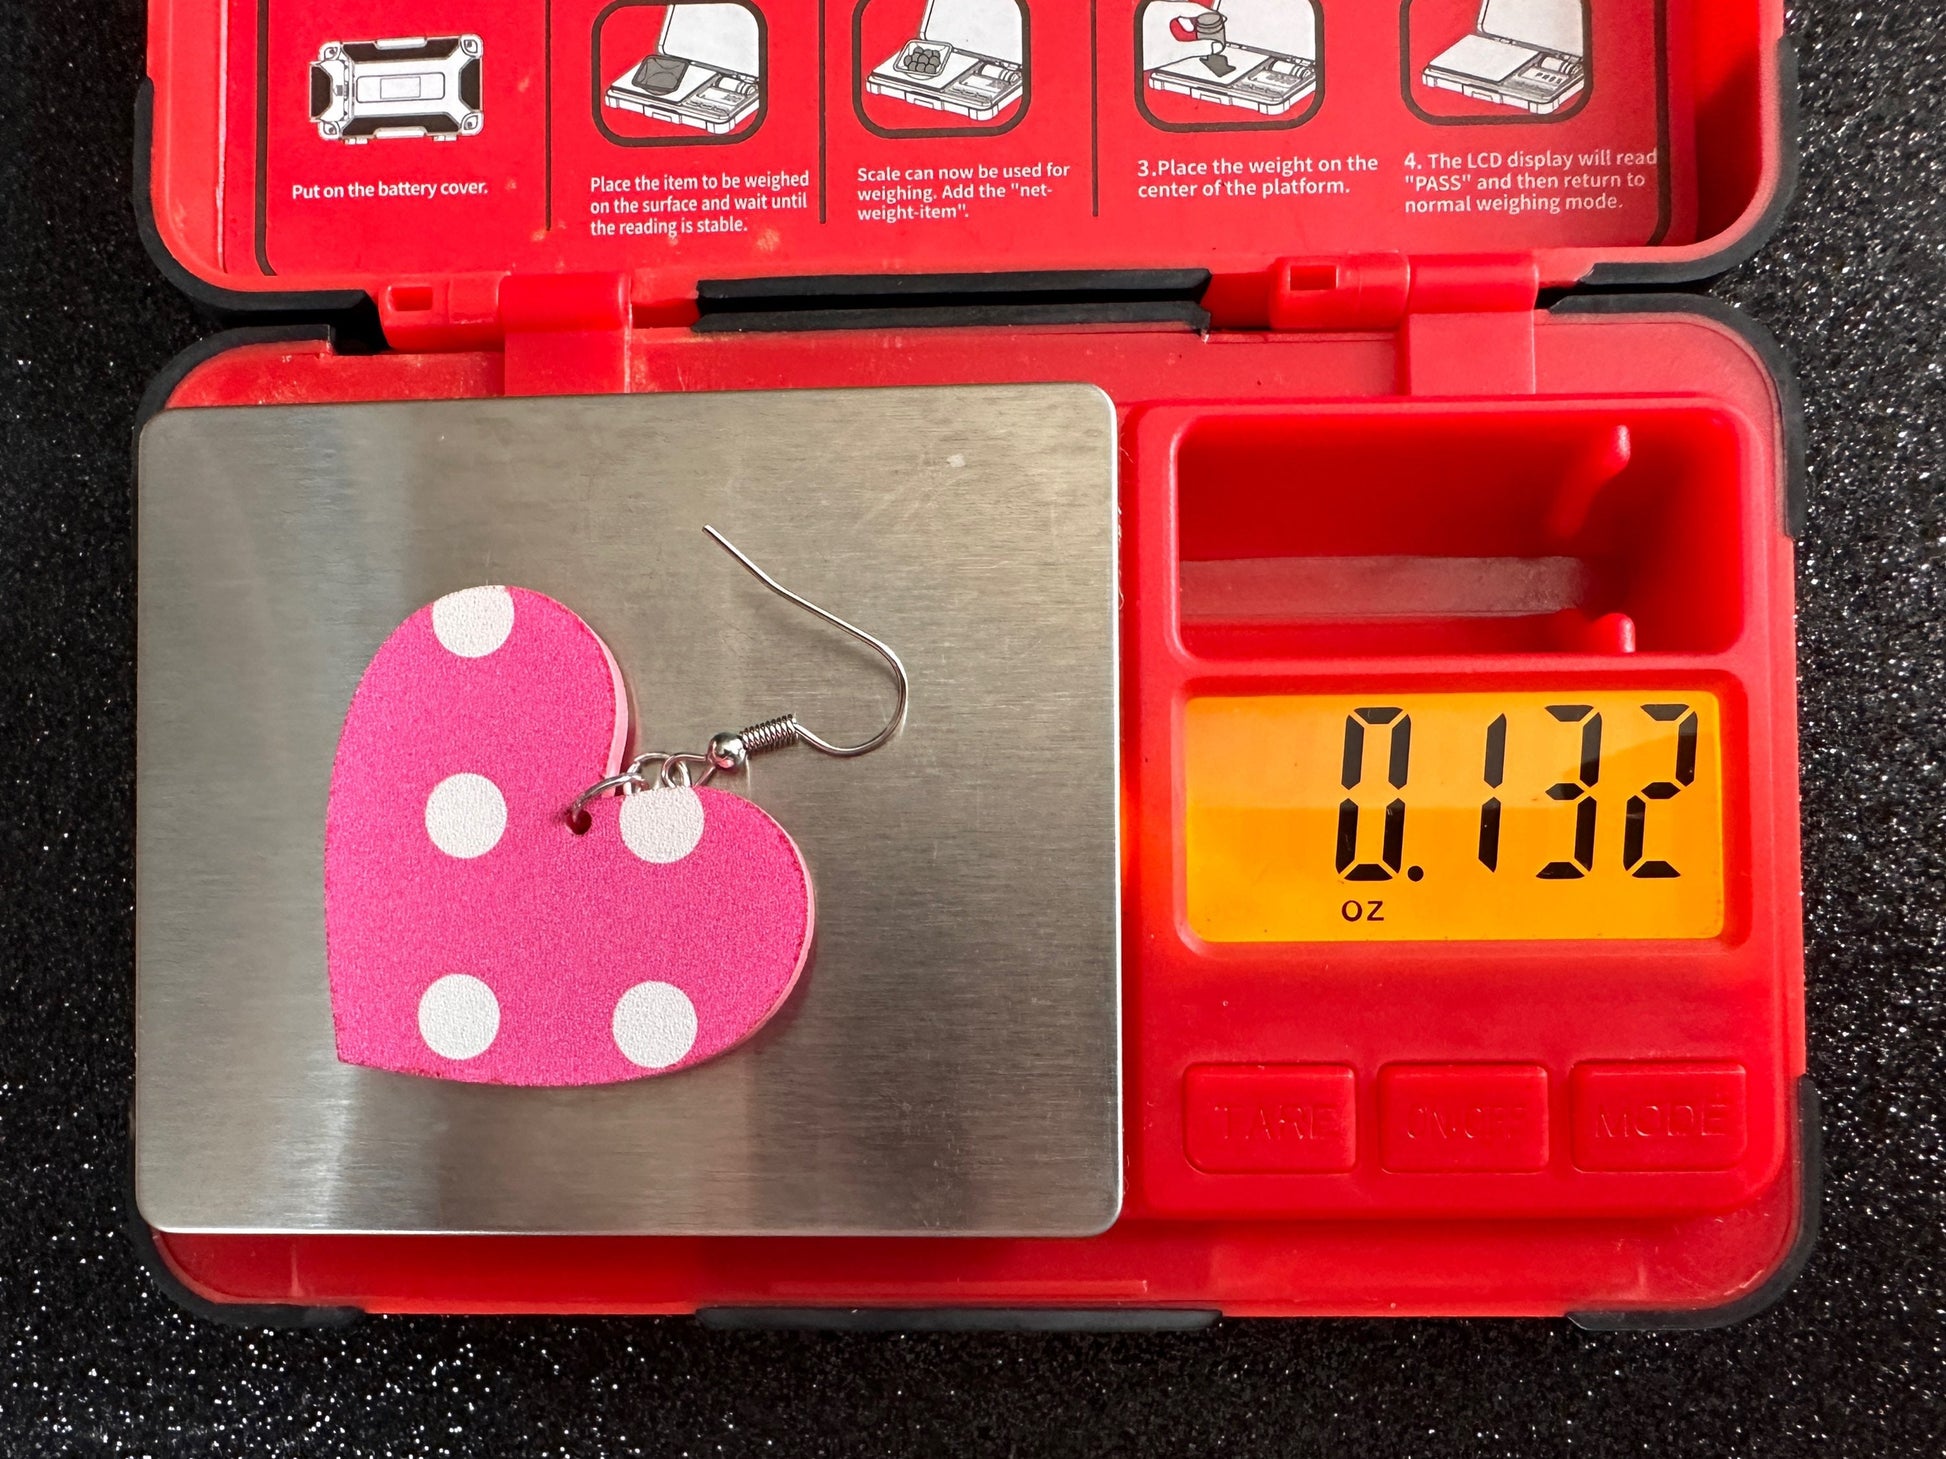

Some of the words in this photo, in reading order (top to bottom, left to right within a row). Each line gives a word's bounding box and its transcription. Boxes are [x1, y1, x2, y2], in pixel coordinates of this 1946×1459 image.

[1212, 157, 1244, 175] the
[1248, 156, 1313, 177] weight
[1318, 159, 1342, 172] on
[1346, 153, 1378, 171] the
[1404, 151, 1422, 170] 4.
[1427, 152, 1462, 169] The
[1467, 152, 1503, 168] LCD
[1507, 150, 1573, 171] display
[1577, 149, 1611, 167] will
[1616, 147, 1658, 166] read
[590, 175, 631, 193] Place
[634, 174, 660, 192] the
[664, 173, 698, 192] item
[701, 173, 718, 190] to
[721, 171, 740, 189] be
[744, 168, 811, 192] weighed
[857, 166, 901, 182] Scale
[904, 168, 934, 181] can
[938, 168, 974, 180] now
[978, 163, 999, 179] be
[1003, 162, 1042, 179] used
[1046, 162, 1071, 177] for
[1405, 173, 1471, 192] "PASS"
[1477, 172, 1512, 190] and
[1516, 171, 1558, 189] then
[1564, 173, 1621, 188] return
[1627, 172, 1645, 187] to
[291, 183, 321, 200] Put
[320, 185, 345, 200] on
[346, 181, 376, 200] the
[377, 180, 438, 199] battery
[440, 181, 488, 196] cover.
[856, 184, 938, 203] weighing.
[941, 182, 974, 199] Add
[978, 182, 1006, 198] the
[1010, 181, 1053, 197] "net-
[1138, 181, 1198, 198] center
[1202, 178, 1222, 197] of
[1224, 179, 1256, 196] the
[1262, 176, 1350, 199] platform.
[589, 200, 610, 215] on
[613, 195, 639, 215] the
[642, 195, 698, 213] surface
[701, 193, 731, 211] and
[733, 191, 769, 210] wait
[771, 191, 808, 209] until
[857, 200, 969, 224] weight-item".
[1405, 195, 1471, 213] normal
[1476, 193, 1561, 215] weighing
[1565, 192, 1623, 210] mode.
[589, 218, 617, 236] the
[618, 217, 680, 237] reading
[680, 215, 694, 234] is
[696, 215, 748, 233] stable.
[1334, 703, 1699, 882] 0.132
[1594, 1102, 1728, 1139] MODE
